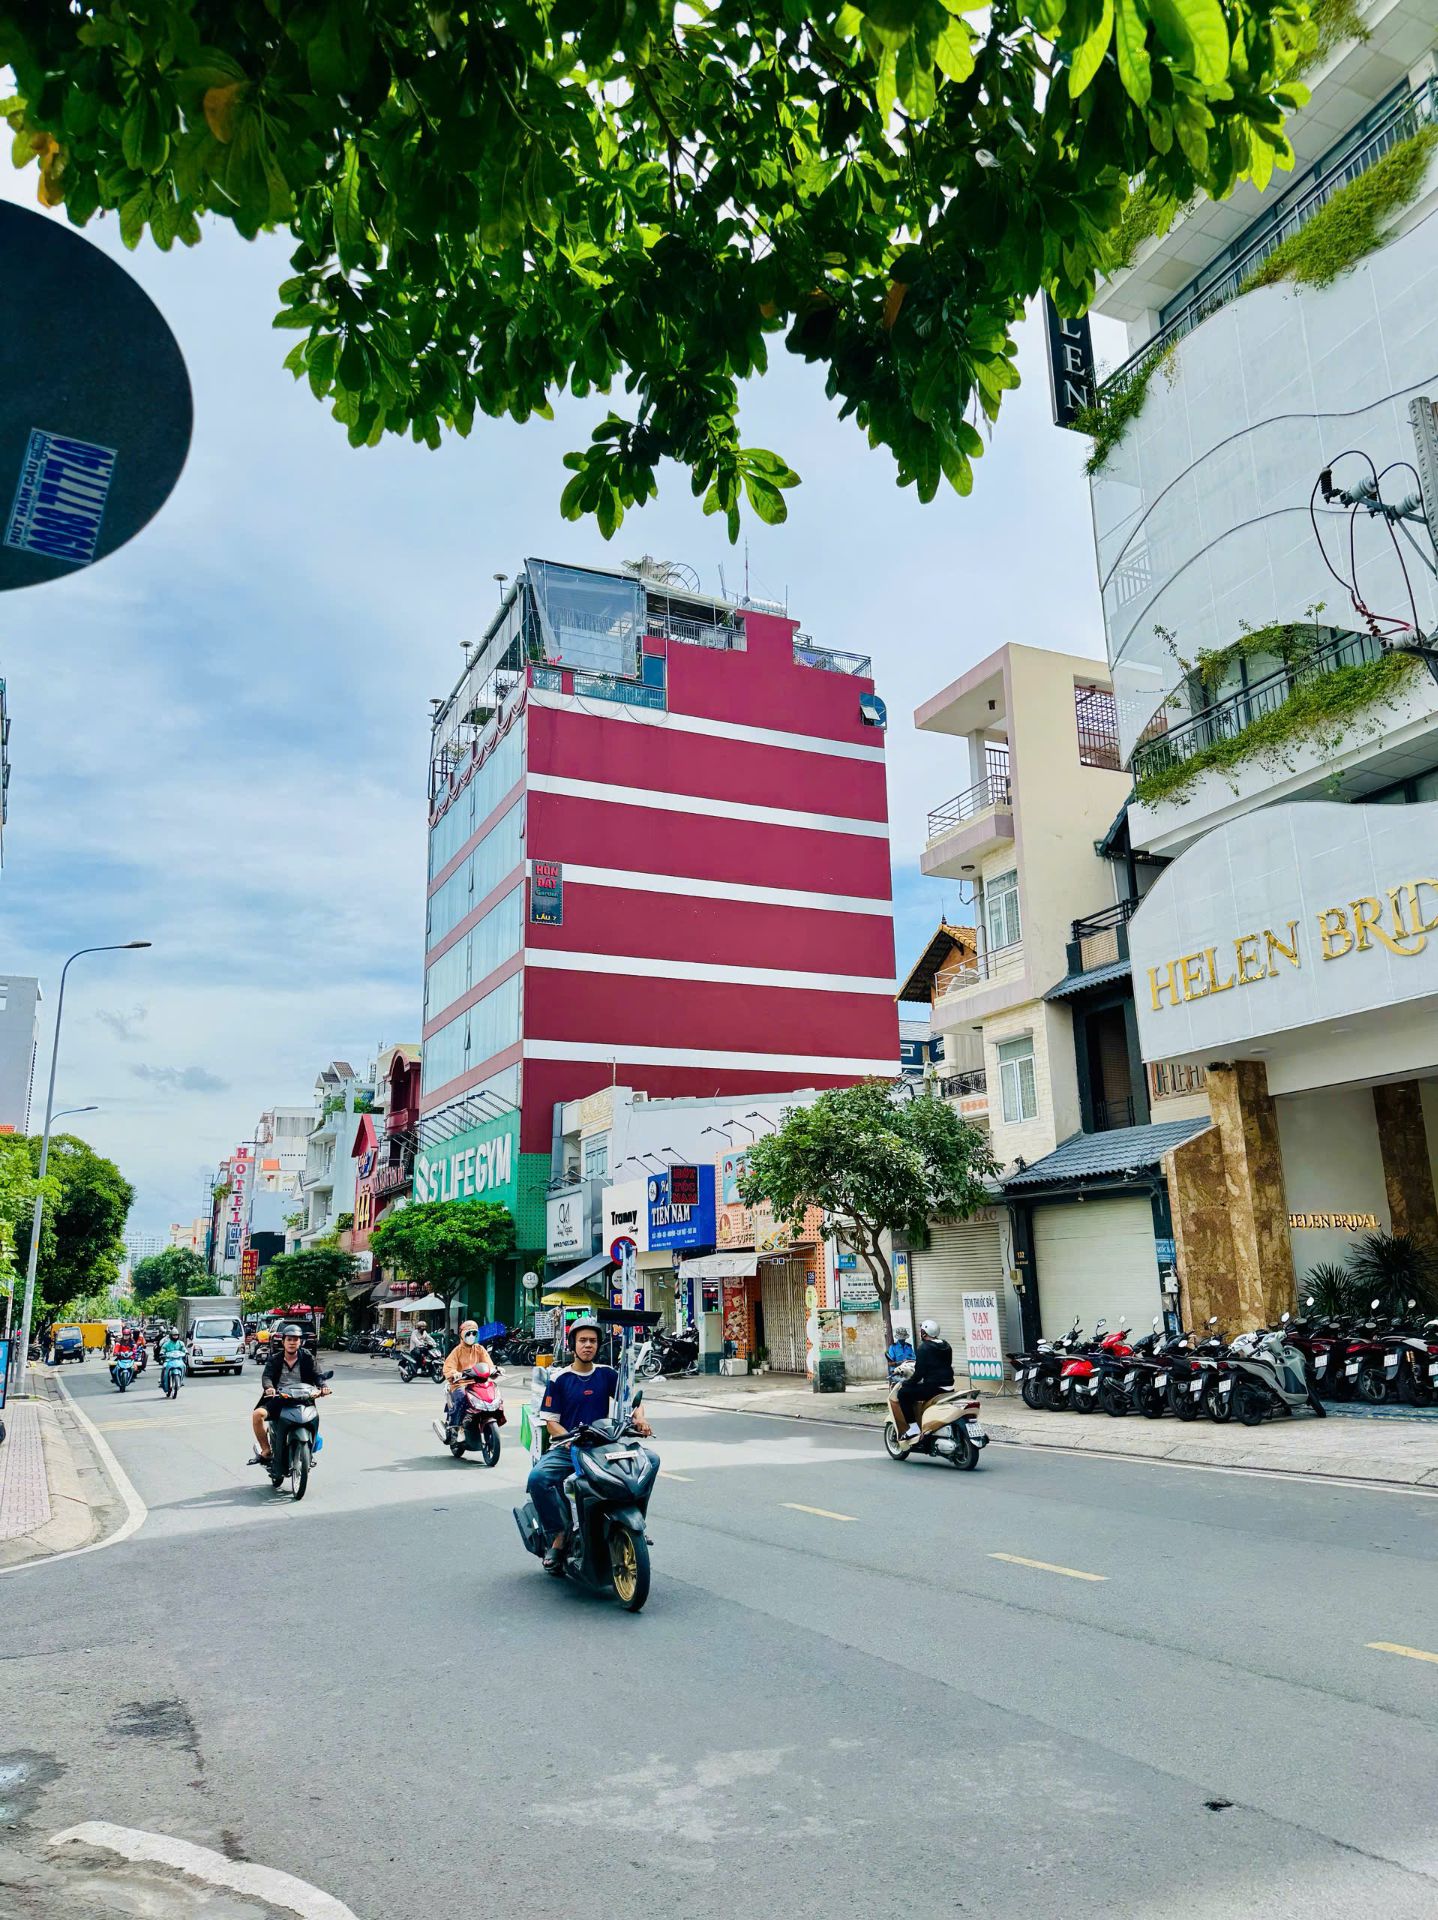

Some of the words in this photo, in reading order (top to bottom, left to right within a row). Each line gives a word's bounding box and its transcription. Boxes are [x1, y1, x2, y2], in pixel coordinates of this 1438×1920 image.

[1060, 317, 1089, 409] LEN
[1147, 919, 1301, 1011] HELEN
[1316, 877, 1438, 961] BRID
[232, 1147, 249, 1223] HOTEL
[1288, 1213, 1331, 1229] HELEN
[1332, 1213, 1382, 1232] BRIDAL
[971, 1328, 993, 1341] SANH
